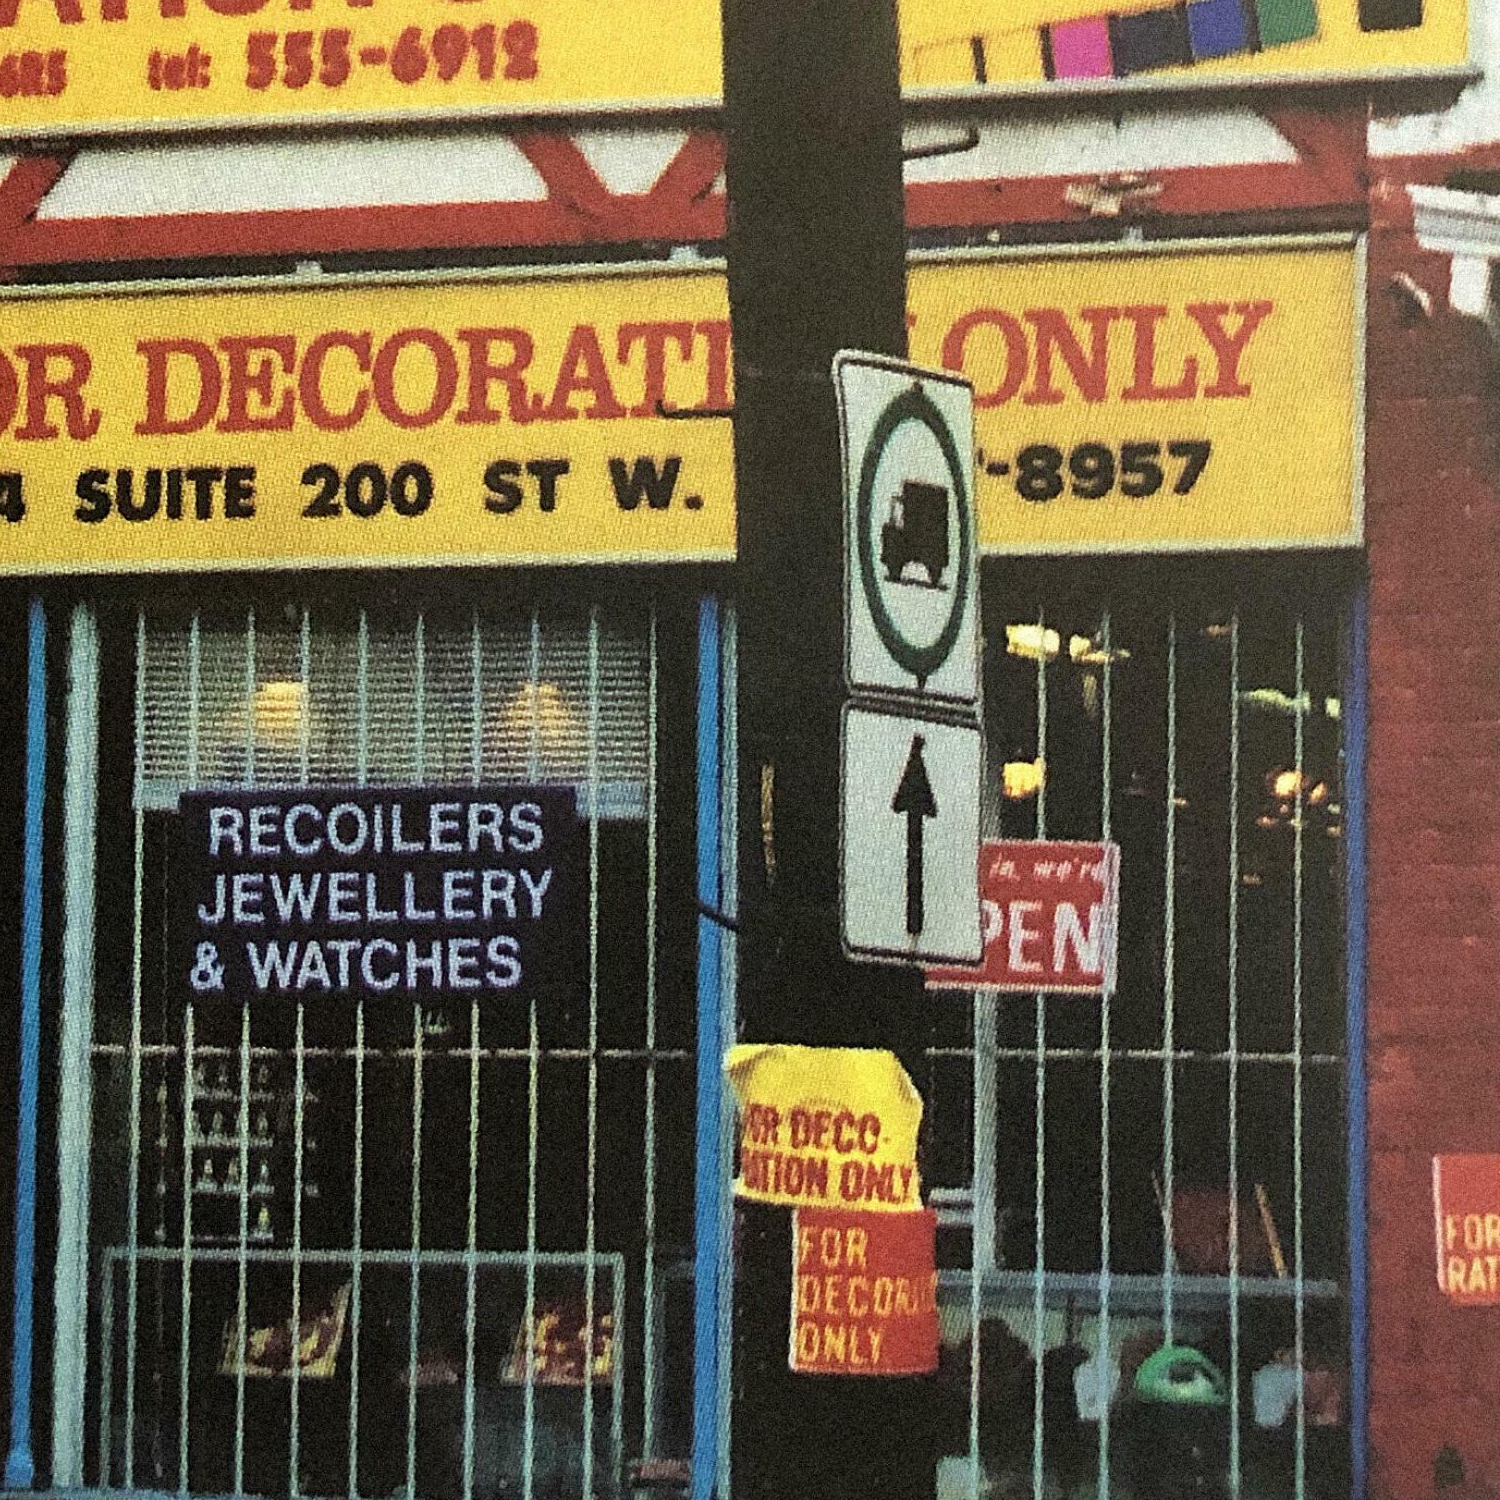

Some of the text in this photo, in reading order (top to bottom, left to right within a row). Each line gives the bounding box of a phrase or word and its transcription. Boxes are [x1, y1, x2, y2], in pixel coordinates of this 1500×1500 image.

[244, 18, 539, 92] 555-6912
[133, 319, 731, 436] DECORATI
[941, 300, 1274, 410] ONLY
[73, 465, 257, 522] SUITE
[300, 461, 434, 517] 200
[482, 458, 571, 514] ST
[607, 455, 703, 511] W.
[976, 440, 1212, 501] -8957
[208, 802, 545, 855] RECOILERS
[197, 868, 553, 924] JEWELLERY
[190, 935, 523, 991] & WATCHES
[982, 900, 1101, 974] PEN
[838, 1160, 913, 1202] ONLY
[801, 1225, 869, 1269] FOR
[799, 1321, 884, 1366] ONLY
